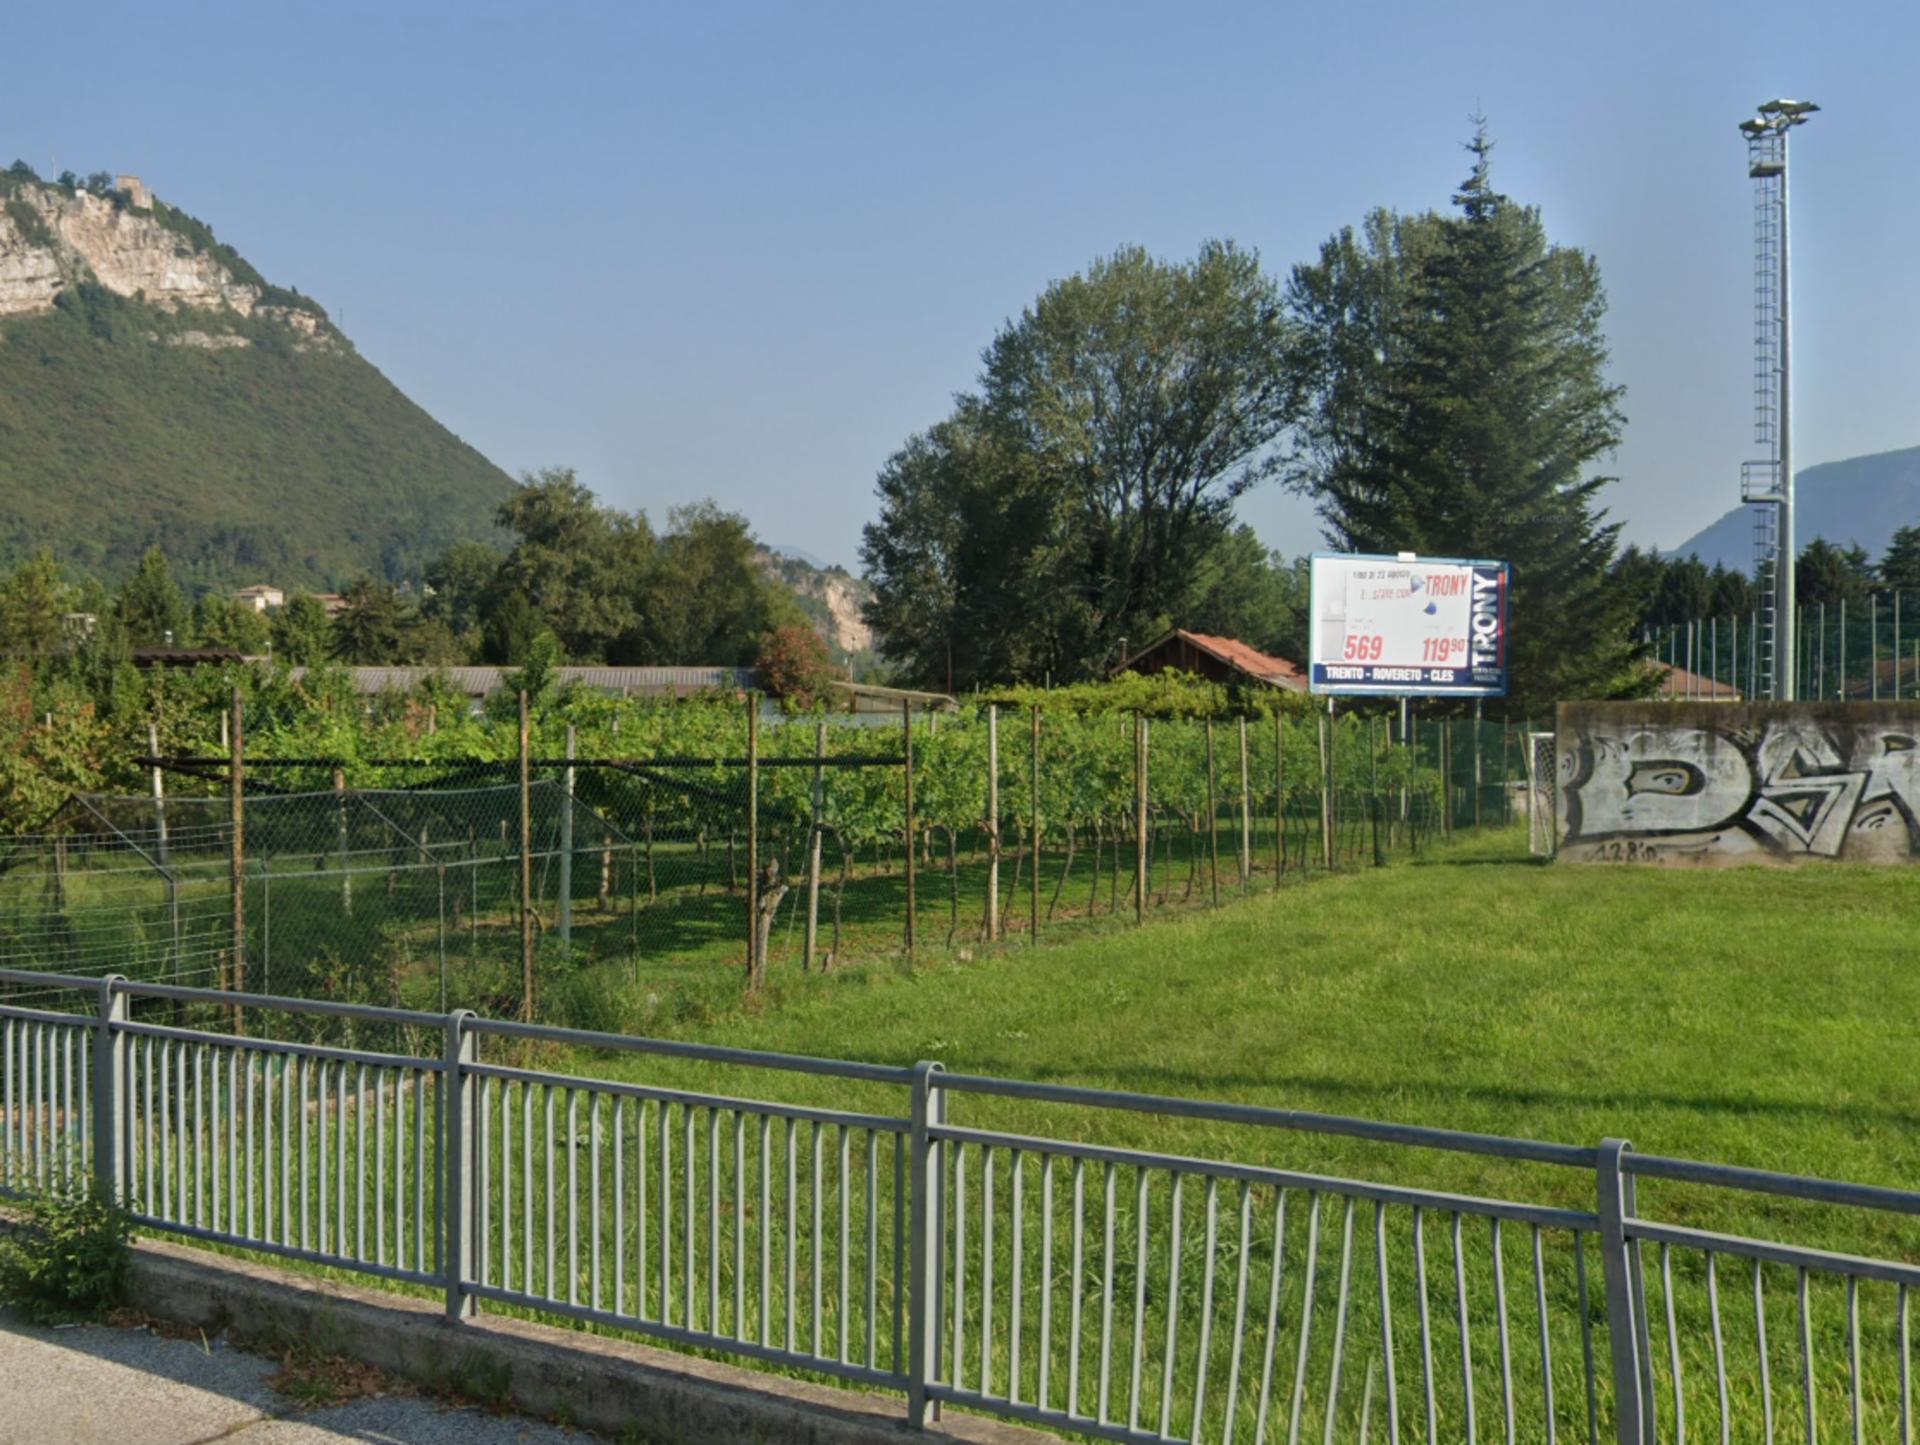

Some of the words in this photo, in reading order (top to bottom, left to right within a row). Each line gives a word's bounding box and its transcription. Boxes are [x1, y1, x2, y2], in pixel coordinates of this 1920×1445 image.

[1426, 574, 1468, 597] TRONY
[1472, 573, 1498, 668] TRONY
[1344, 635, 1383, 660] 569
[1325, 666, 1364, 680] TRENTO
[1373, 668, 1422, 681] ROVERETO
[1431, 670, 1454, 682] CLES
